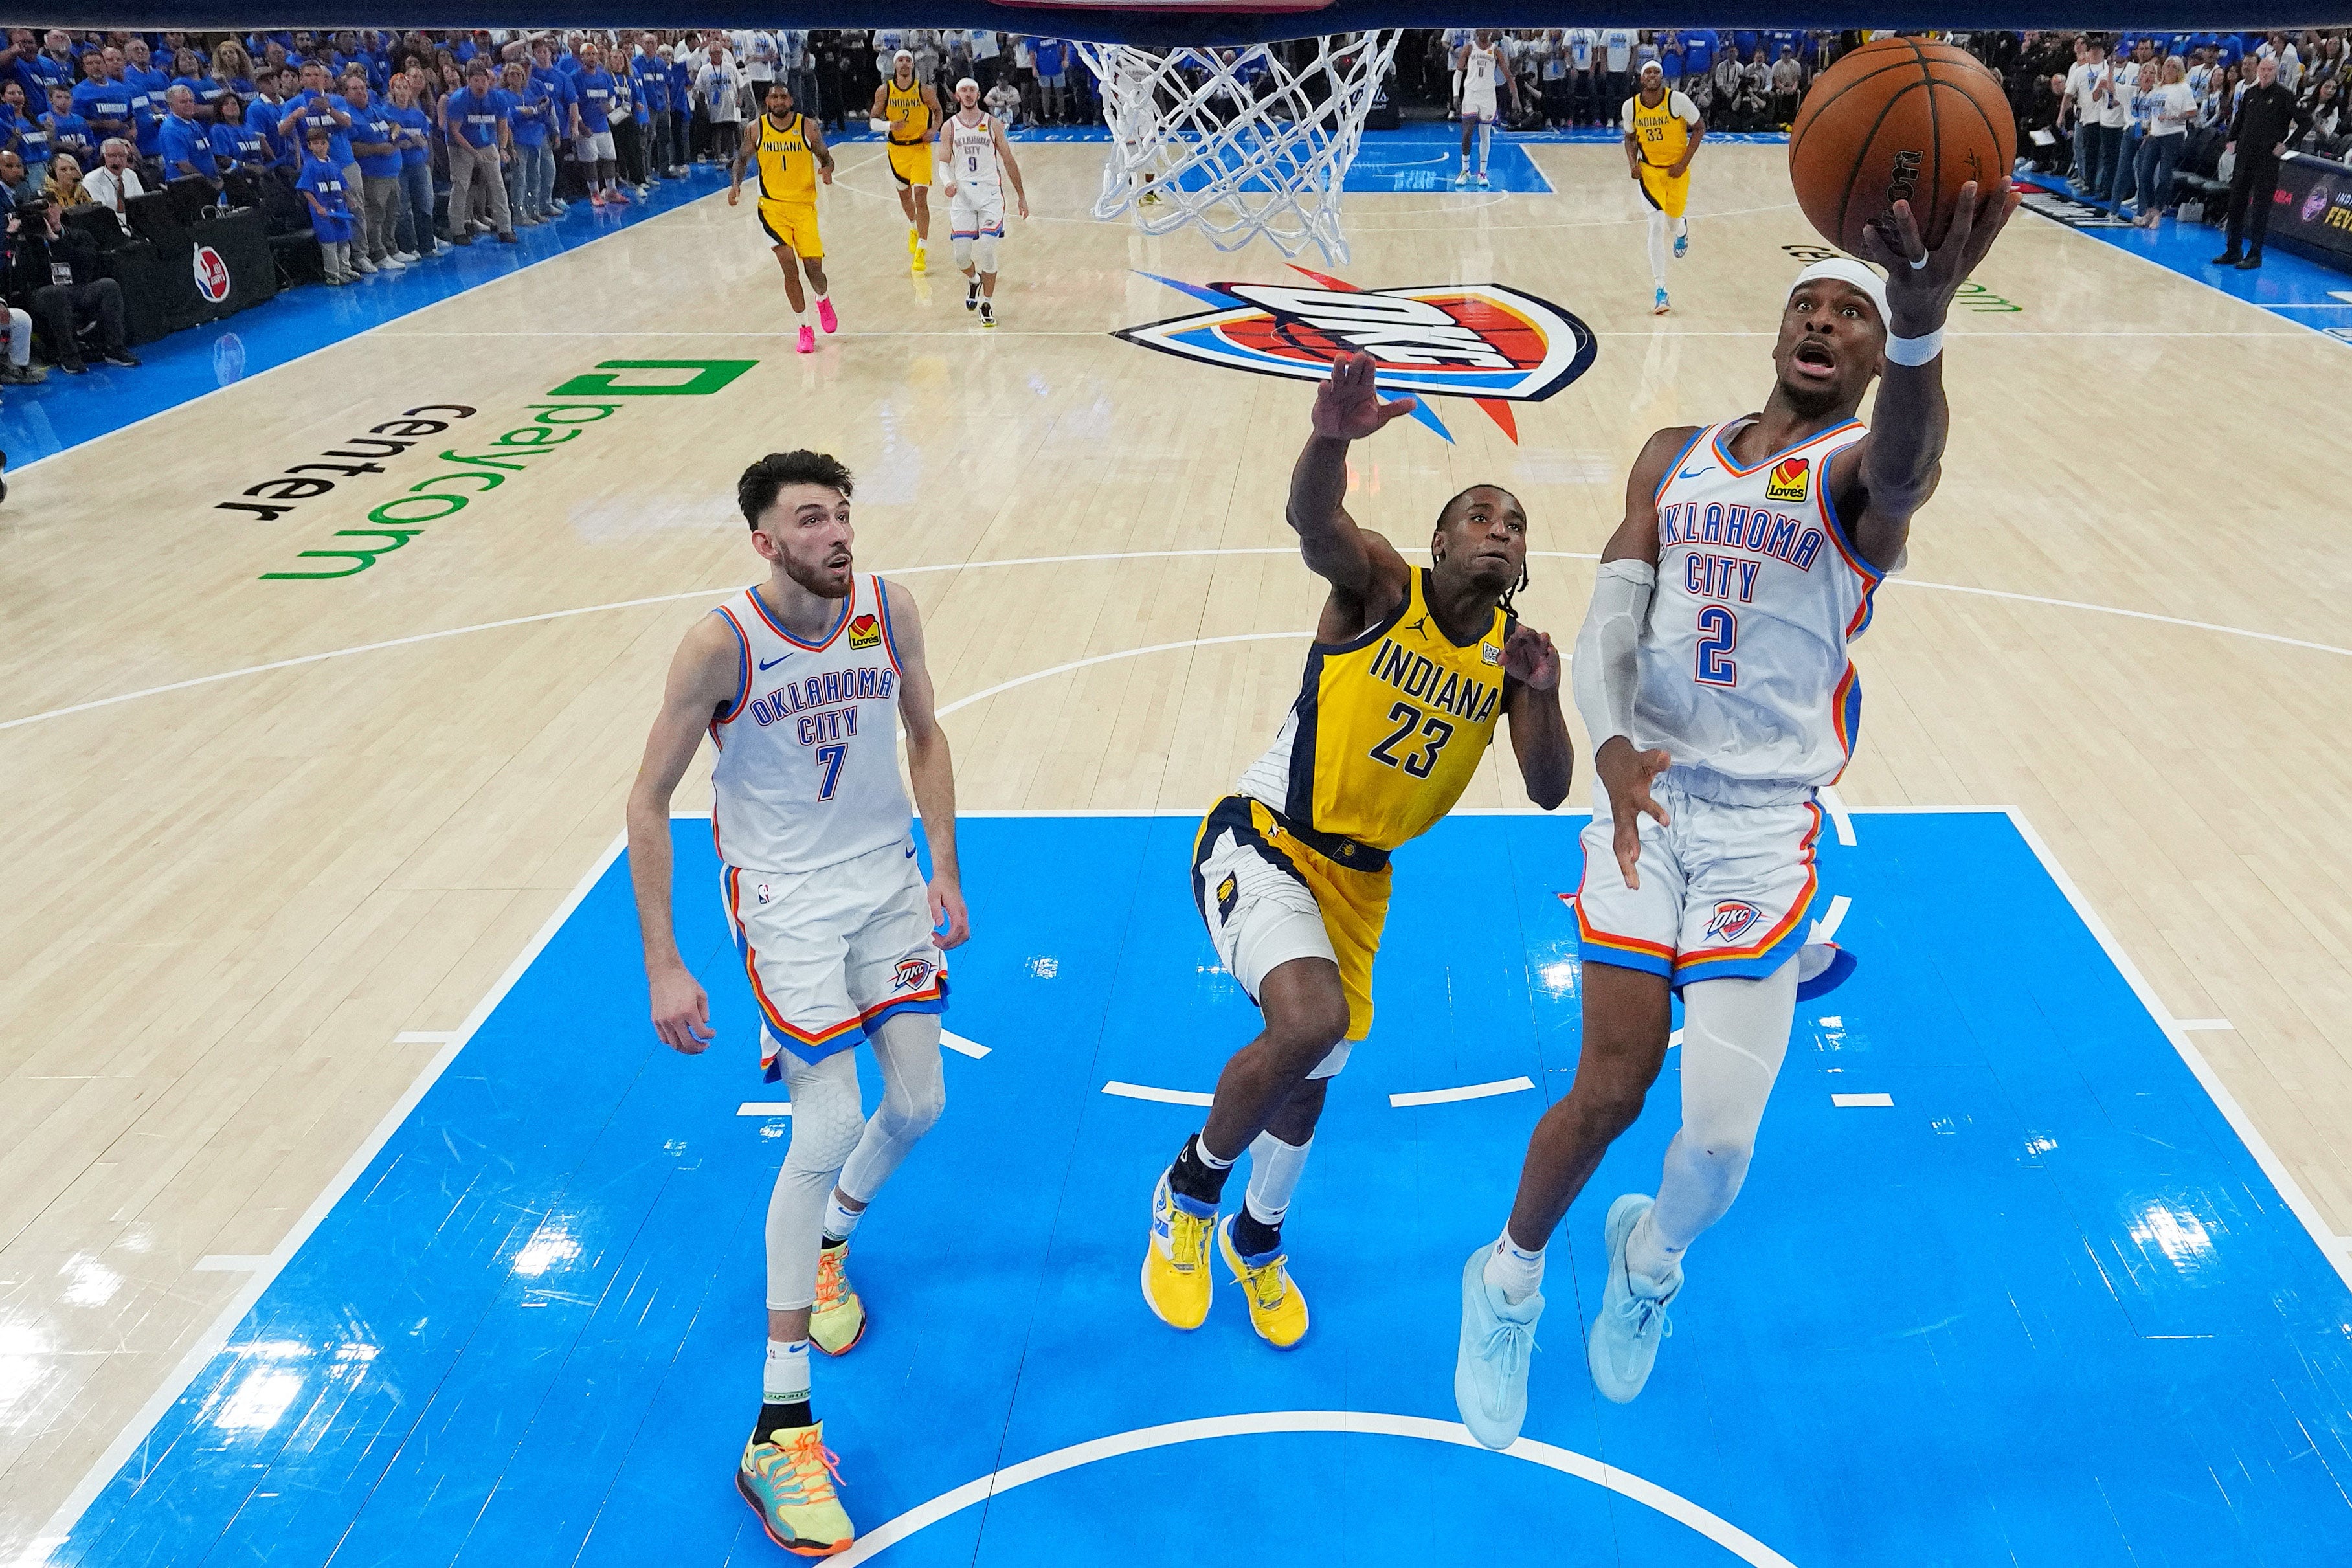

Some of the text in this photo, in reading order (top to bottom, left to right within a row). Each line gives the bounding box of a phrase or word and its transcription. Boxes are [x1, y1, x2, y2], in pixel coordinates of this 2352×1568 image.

[890, 98, 921, 107] INDIANA
[902, 109, 910, 123] 2
[763, 141, 803, 153] INDIANA
[1646, 127, 1664, 142] 33
[781, 155, 787, 171] 1
[968, 156, 978, 172] 9
[214, 403, 477, 522] center
[259, 403, 623, 581] paycom
[1769, 483, 1804, 500] Love's
[1685, 551, 1762, 603] CITY
[1694, 604, 1737, 688] 2
[750, 667, 895, 727] OKLAHOMA
[1369, 637, 1500, 724] INDIANA
[797, 705, 858, 746] CITY
[1368, 701, 1455, 780] 23
[816, 743, 848, 802] 7
